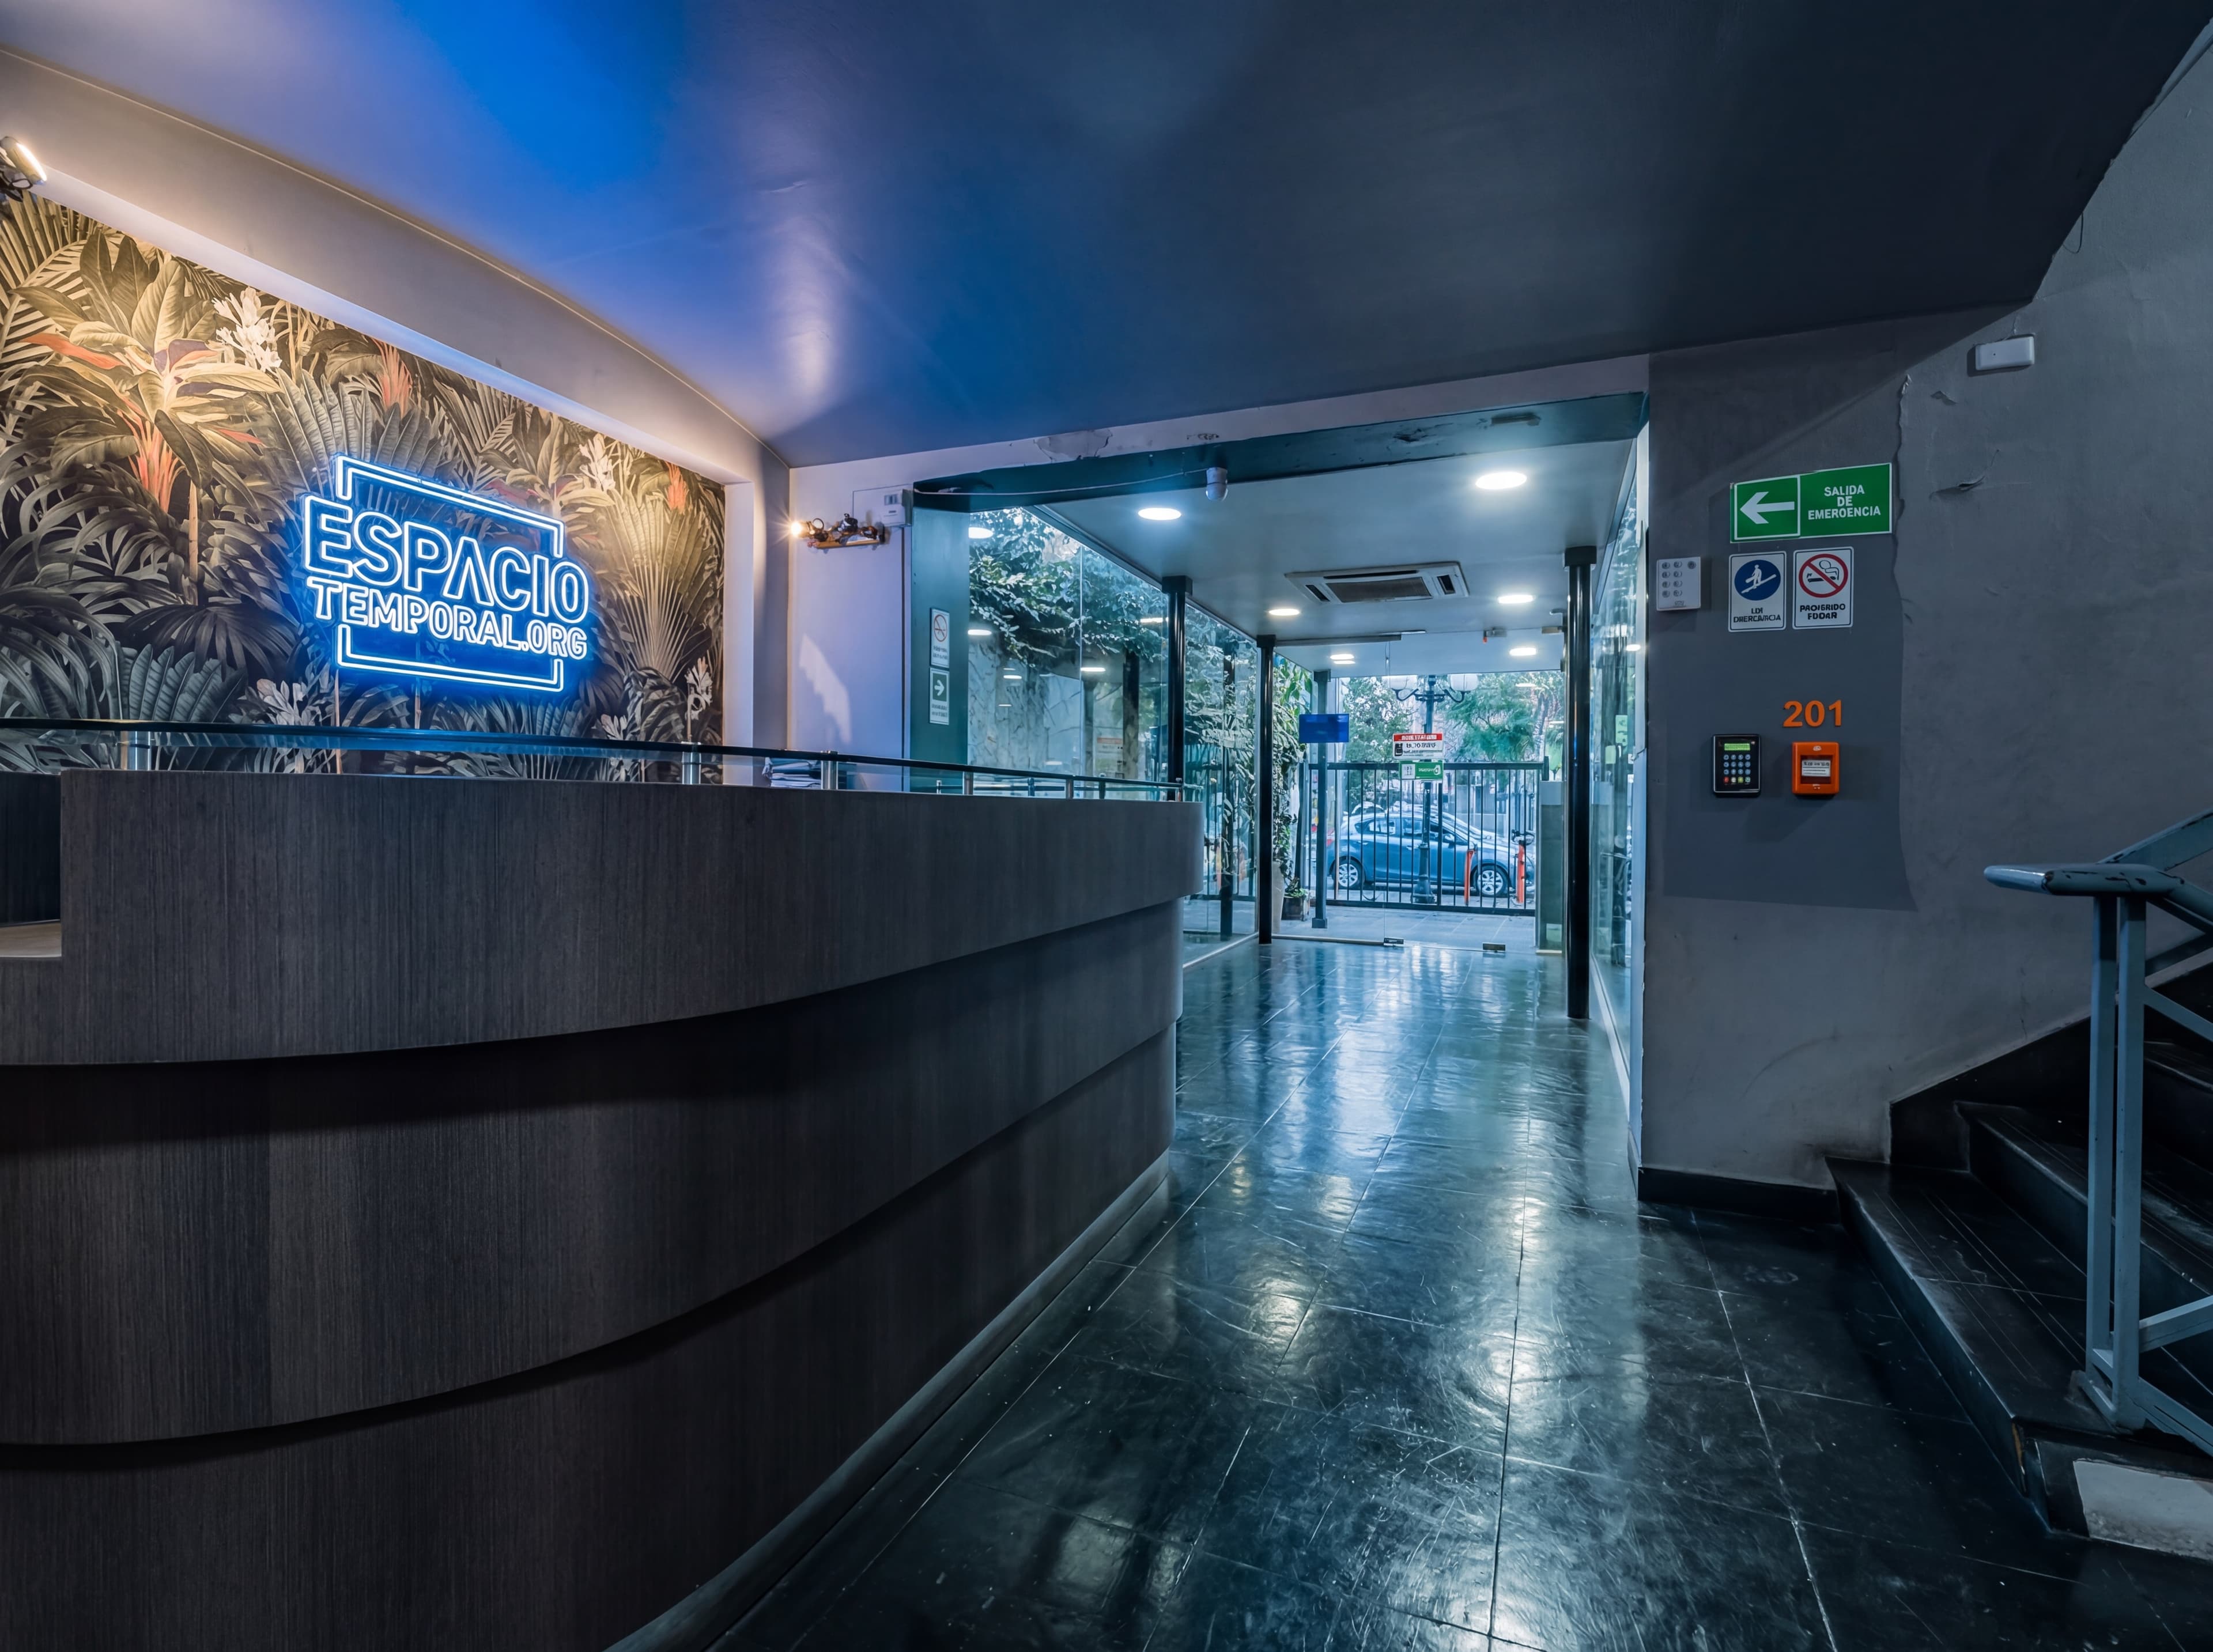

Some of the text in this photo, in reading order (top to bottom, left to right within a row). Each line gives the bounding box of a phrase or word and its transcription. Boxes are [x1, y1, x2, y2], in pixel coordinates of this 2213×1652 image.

[1824, 485, 1865, 496] SALIDA
[1837, 496, 1853, 506] DE
[305, 496, 589, 623] ESPACIO
[307, 576, 587, 660] TEMPORAL.ORG
[1783, 700, 1842, 727] 201
